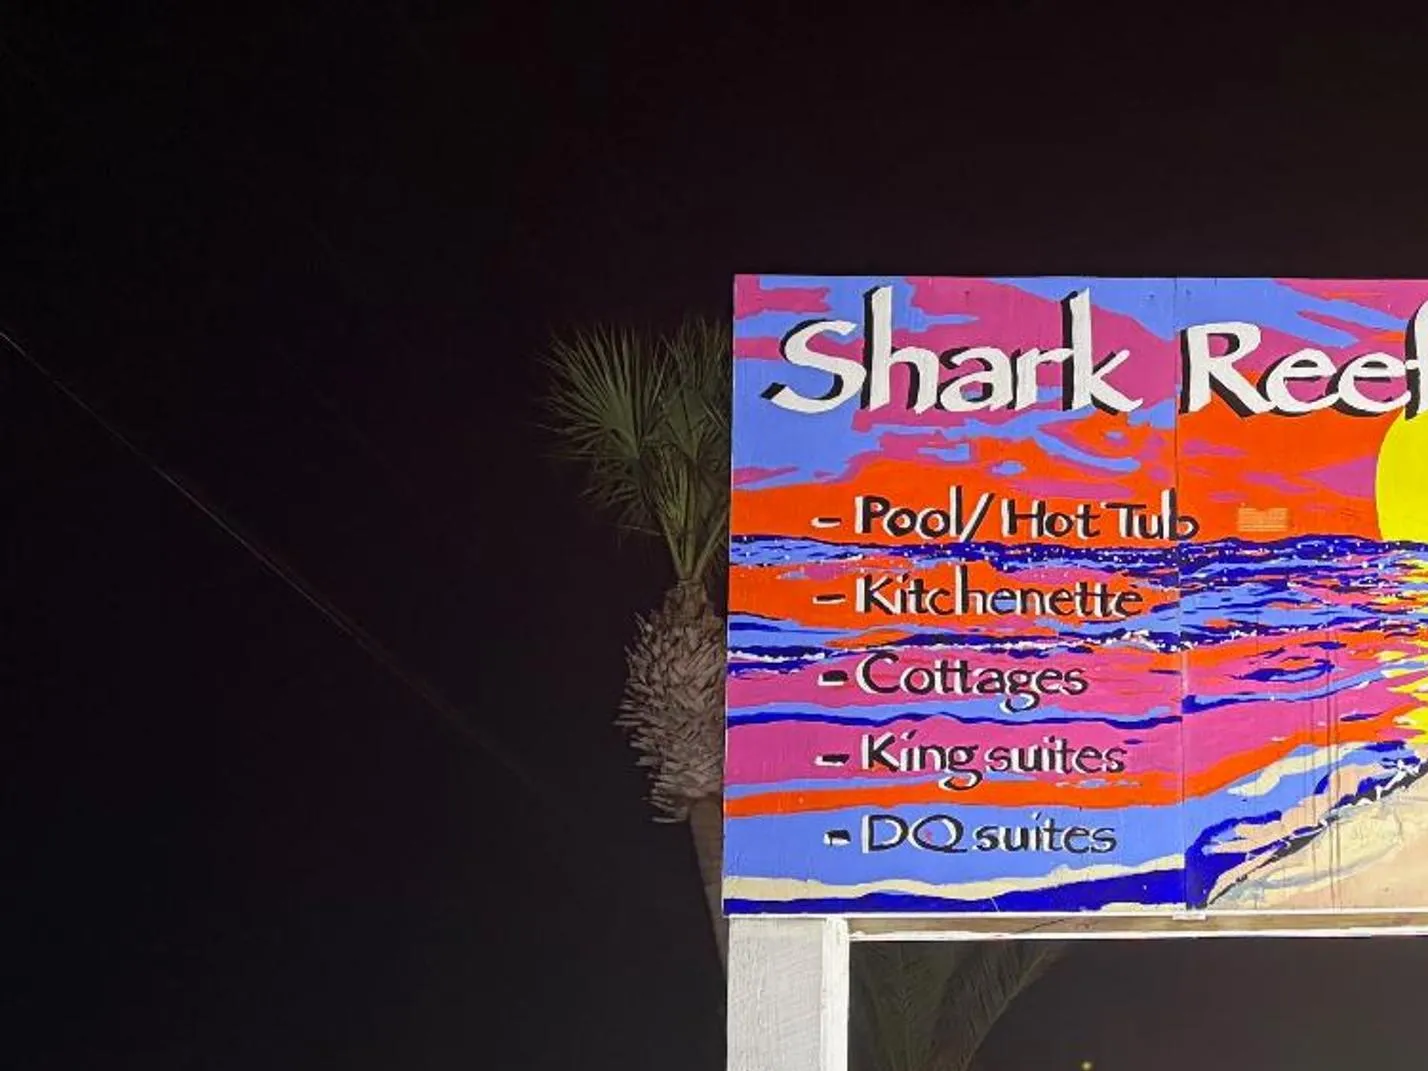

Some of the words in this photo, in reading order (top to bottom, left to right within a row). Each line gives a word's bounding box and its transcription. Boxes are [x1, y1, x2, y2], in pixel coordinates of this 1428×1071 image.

[762, 286, 1143, 414] Shark
[1102, 487, 1200, 542] Tub
[854, 564, 1144, 617] Kitchenette
[856, 652, 1089, 713] Cottages
[861, 729, 984, 791] King
[986, 735, 1128, 774] suites
[973, 811, 1118, 854] suites
